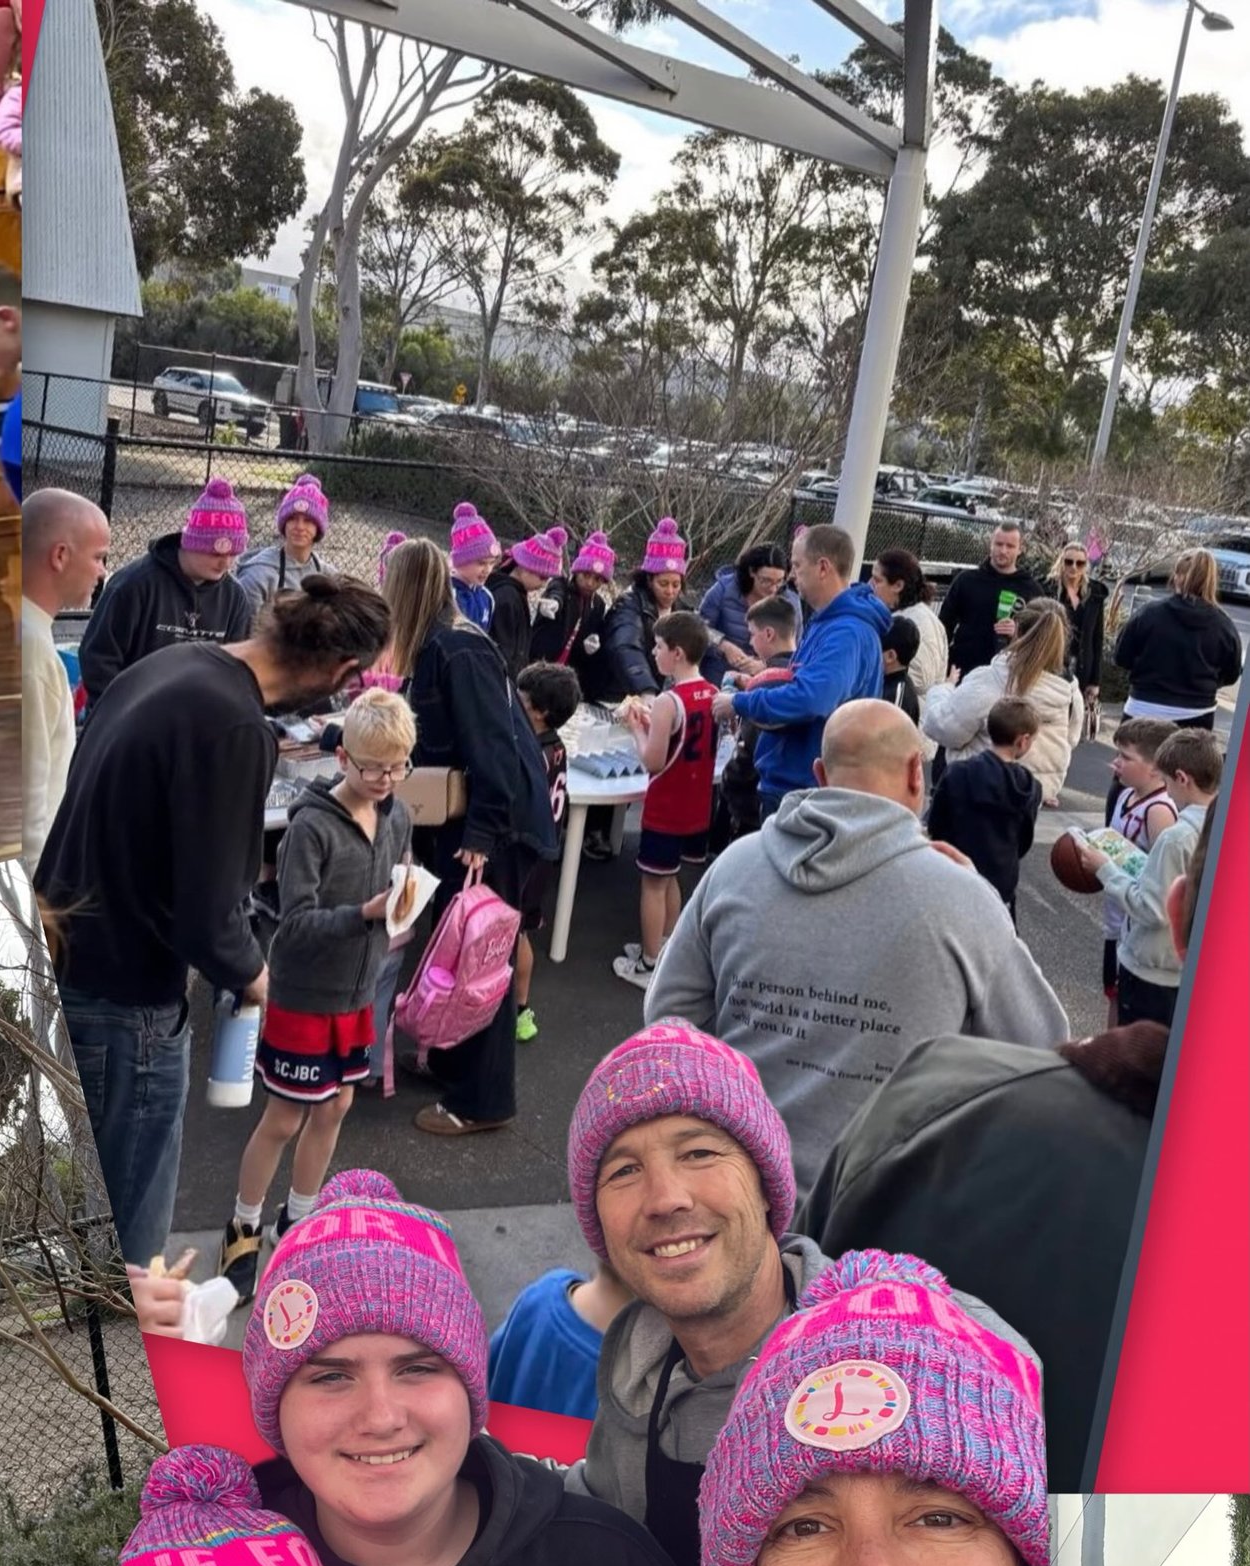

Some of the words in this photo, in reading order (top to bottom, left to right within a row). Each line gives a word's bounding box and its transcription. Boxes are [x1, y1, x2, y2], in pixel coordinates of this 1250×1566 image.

[758, 981, 805, 998] person
[809, 986, 859, 1006] behind
[753, 1020, 778, 1034] you
[796, 1028, 807, 1040] it
[789, 1005, 799, 1018] is
[803, 1011, 810, 1020] a
[812, 1011, 857, 1028] better
[860, 1019, 901, 1035] place
